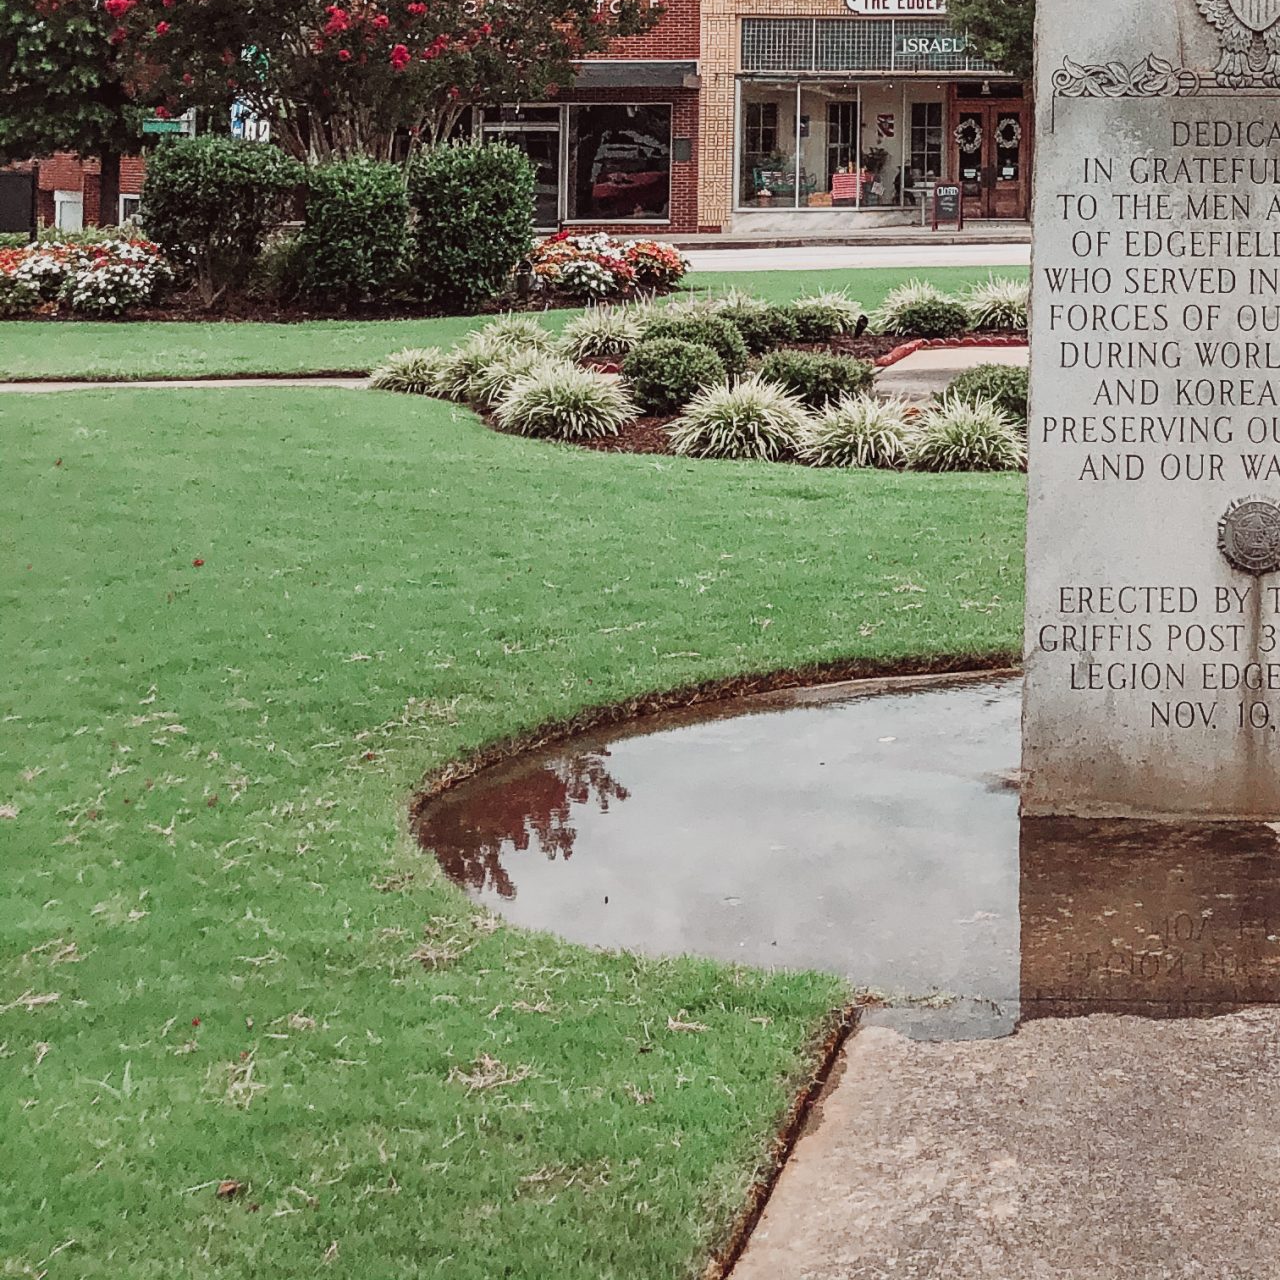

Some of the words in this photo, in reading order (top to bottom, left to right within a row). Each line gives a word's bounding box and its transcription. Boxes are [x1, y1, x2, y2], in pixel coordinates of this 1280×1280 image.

[902, 38, 965, 53] ISRAEL
[1084, 157, 1112, 184] IN
[1056, 194, 1097, 220] TO
[1112, 194, 1171, 221] THE
[1187, 194, 1250, 223] MEN
[1072, 231, 1110, 257] OF
[1043, 267, 1111, 294] WHO
[1125, 268, 1236, 295] SERVED
[1249, 267, 1278, 294] IN
[1050, 304, 1168, 331] FORCES
[1183, 304, 1220, 331] OF
[1060, 340, 1181, 369] DURING
[1093, 379, 1158, 406] AND
[1043, 416, 1233, 443] PRESERVING
[1078, 453, 1144, 480] AND
[1161, 453, 1225, 481] OUR
[1059, 586, 1197, 616] ERECTED
[1215, 587, 1252, 614] BY
[1038, 624, 1152, 653] GRIFFIS
[1168, 624, 1245, 652] POST
[1069, 663, 1184, 693] LEGION
[1151, 701, 1218, 730] NOV.
[1238, 701, 1276, 730] 10,
